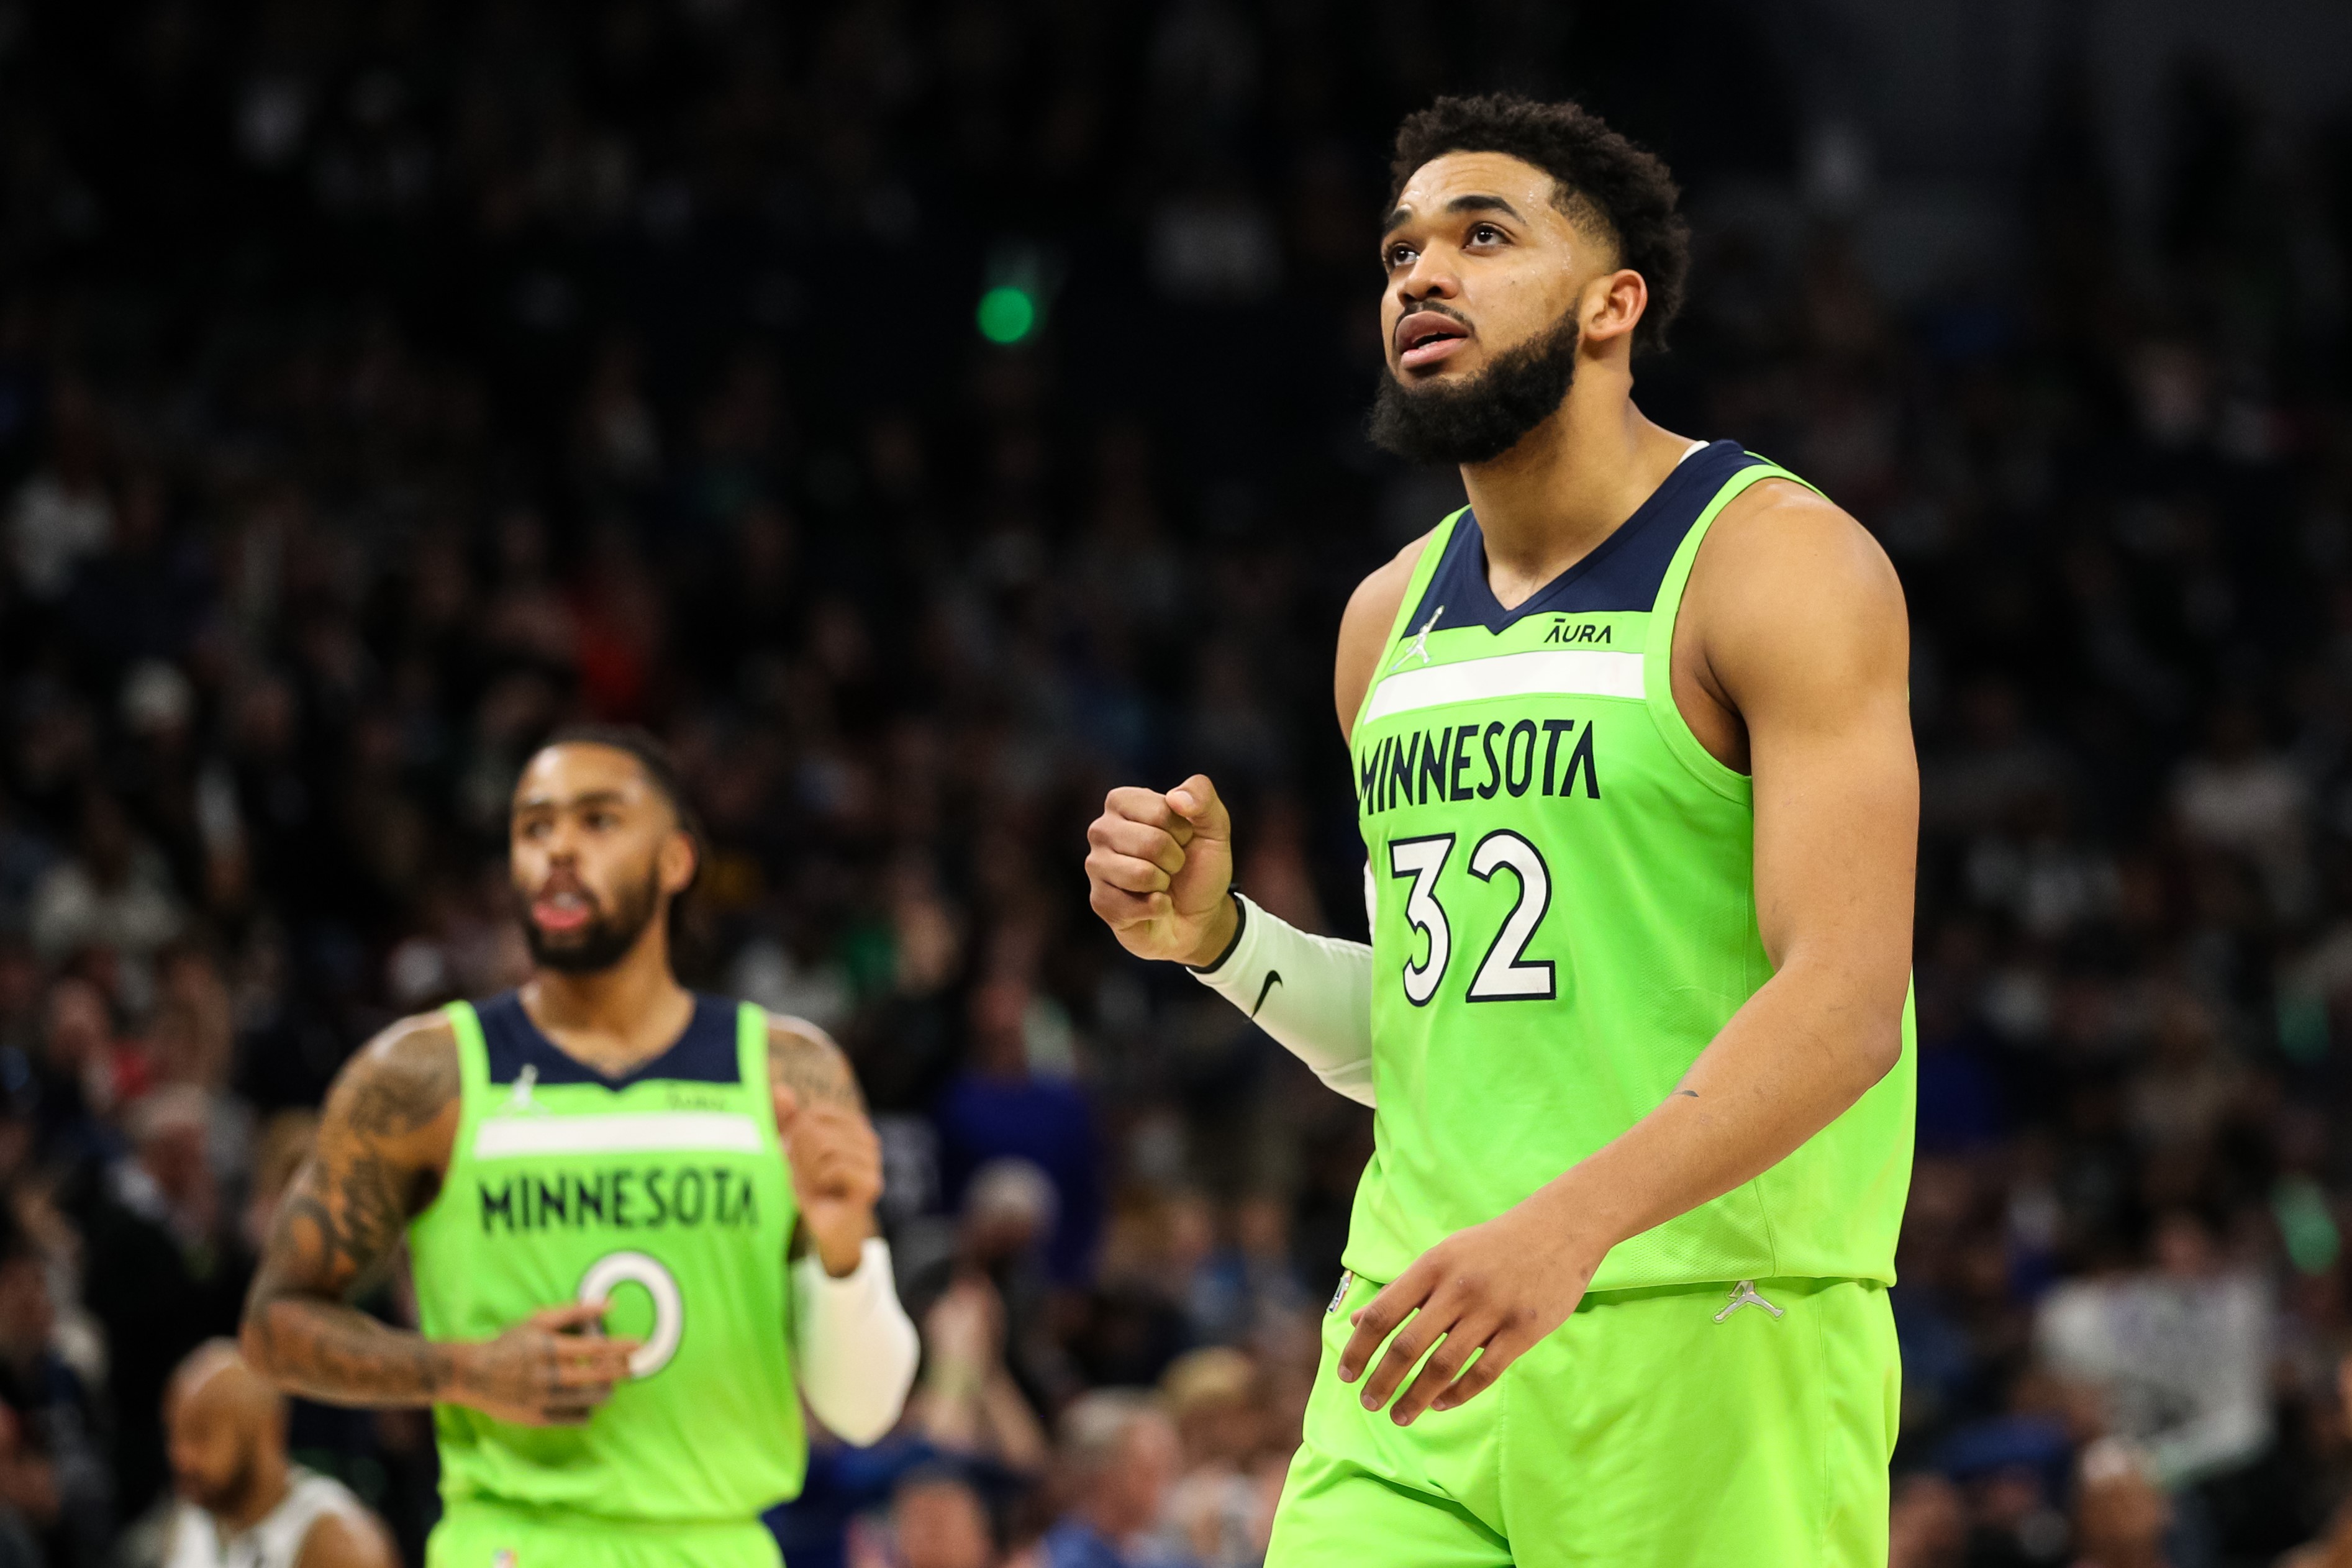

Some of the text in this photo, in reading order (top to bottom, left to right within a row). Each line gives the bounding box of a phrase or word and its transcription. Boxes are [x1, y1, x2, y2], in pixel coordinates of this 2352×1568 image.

[1360, 719, 1601, 816] MINNESOTA
[1389, 828, 1556, 1007] 32
[477, 1164, 759, 1235] MINNESOTA
[576, 1248, 684, 1380] 0
